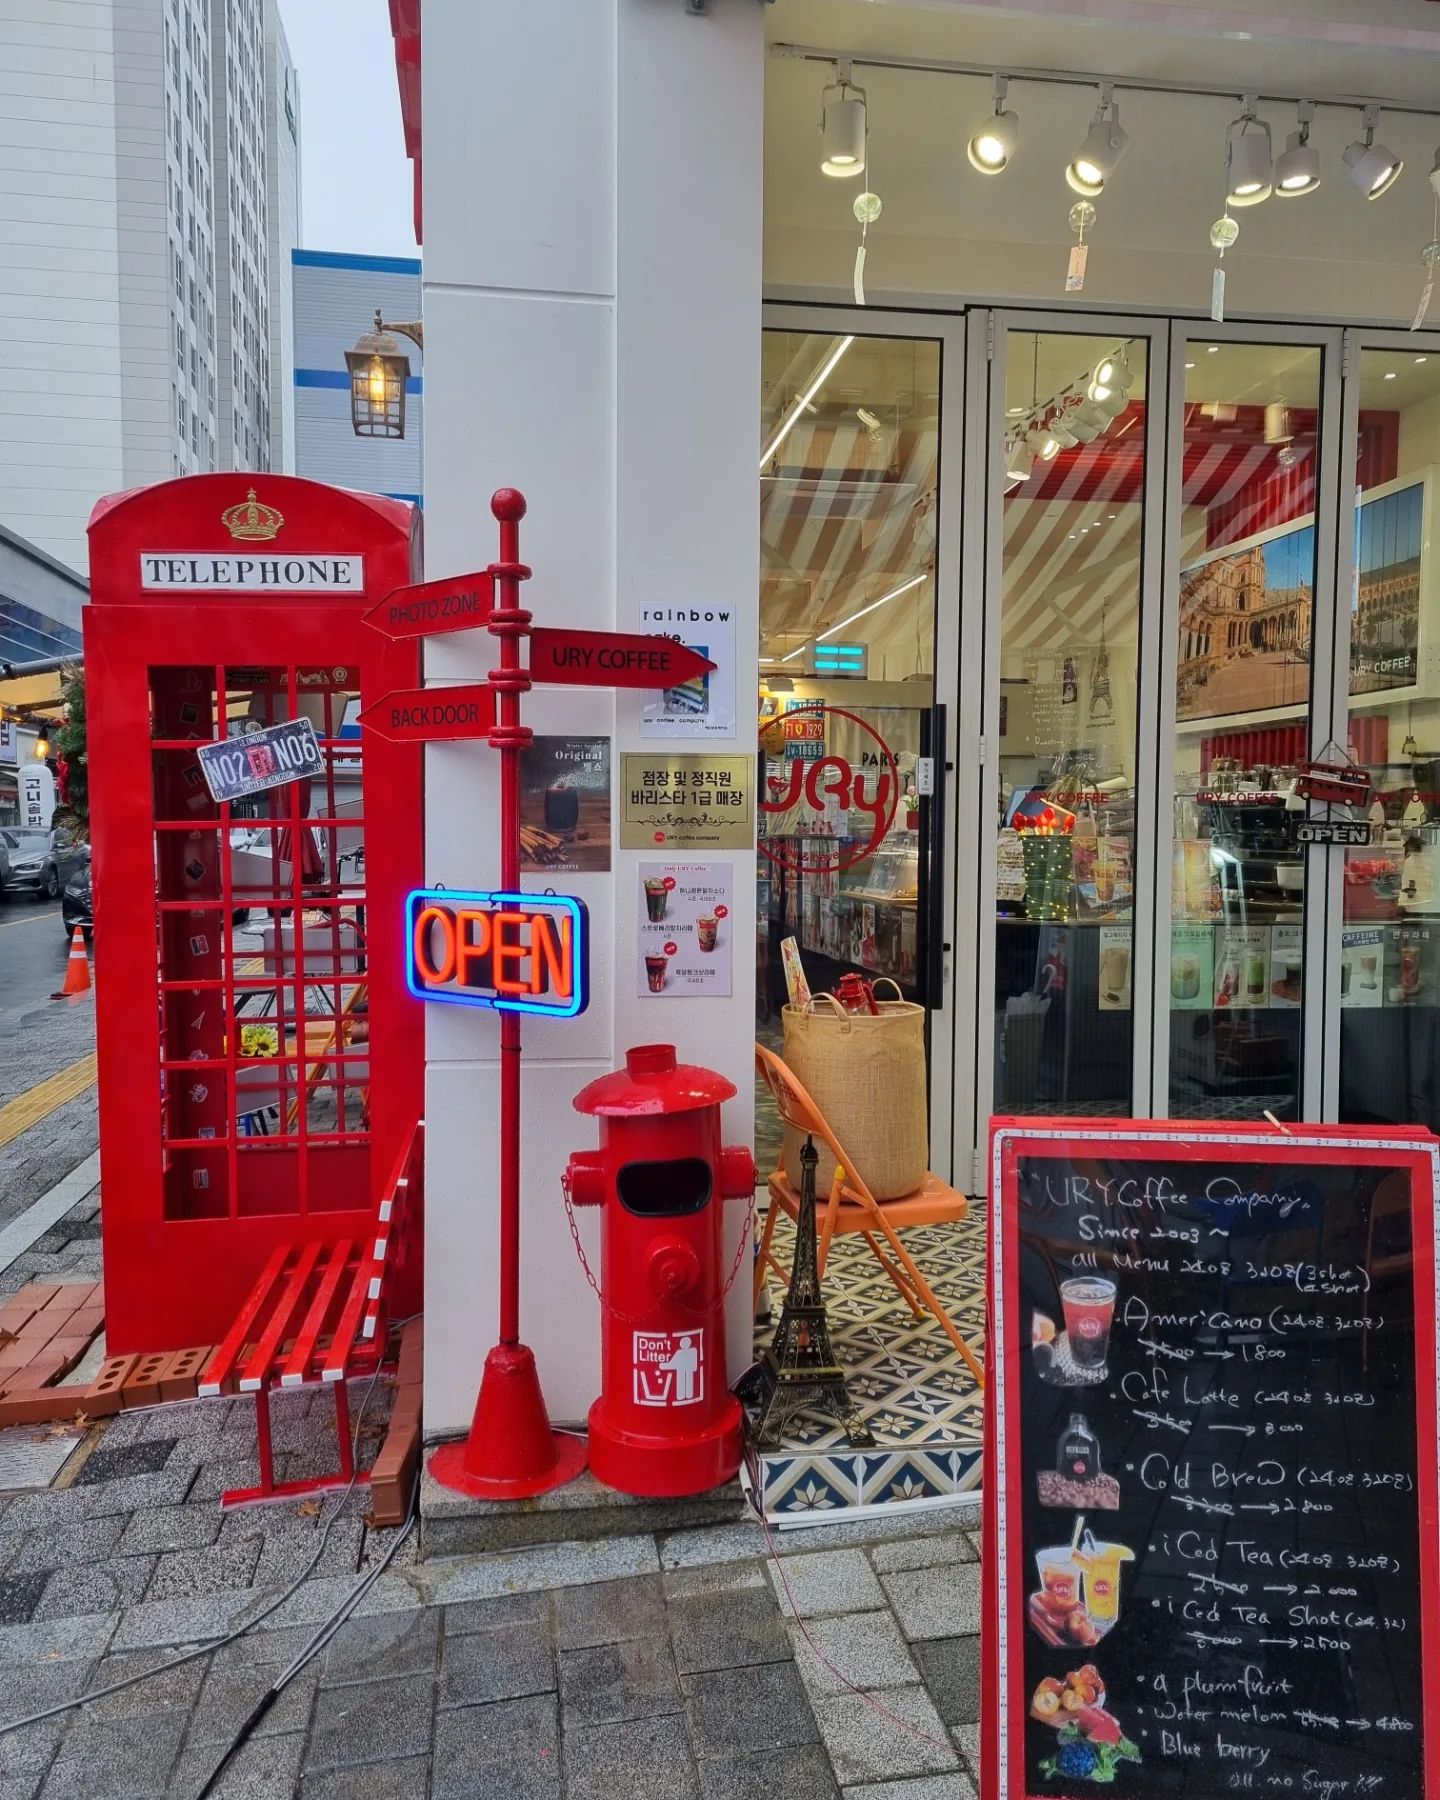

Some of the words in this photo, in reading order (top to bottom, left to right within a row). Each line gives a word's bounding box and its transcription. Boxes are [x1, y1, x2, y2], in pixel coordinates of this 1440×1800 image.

[146, 558, 352, 585] TELEPHONE
[389, 603, 439, 625] PHOTO
[441, 592, 481, 617] ZONE
[643, 609, 731, 622] rainbow
[552, 646, 593, 669] URY
[597, 648, 673, 672] COFFEE
[1374, 655, 1411, 673] COFFEE
[391, 707, 431, 729] BACK
[432, 703, 480, 726] DOOR
[554, 750, 603, 762] Original
[642, 770, 670, 787] 점장
[673, 770, 687, 787] 및
[691, 770, 732, 788] 정직원
[631, 790, 687, 806] 바리스타
[690, 790, 712, 806] 1급
[716, 790, 744, 807] 매장
[1296, 829, 1368, 843] OPEN
[414, 905, 573, 998] OPEN
[1078, 1214, 1141, 1241] Since
[1149, 1225, 1201, 1244] 2003
[1113, 1253, 1170, 1272] Menu
[1121, 1367, 1171, 1404] Cafe
[1140, 1452, 1190, 1491] Cold
[1225, 1540, 1275, 1567] Tea
[1230, 1606, 1272, 1625] Tea
[1288, 1604, 1342, 1627] Shot
[1161, 1729, 1201, 1756] Blue
[1217, 1733, 1271, 1768] berry
